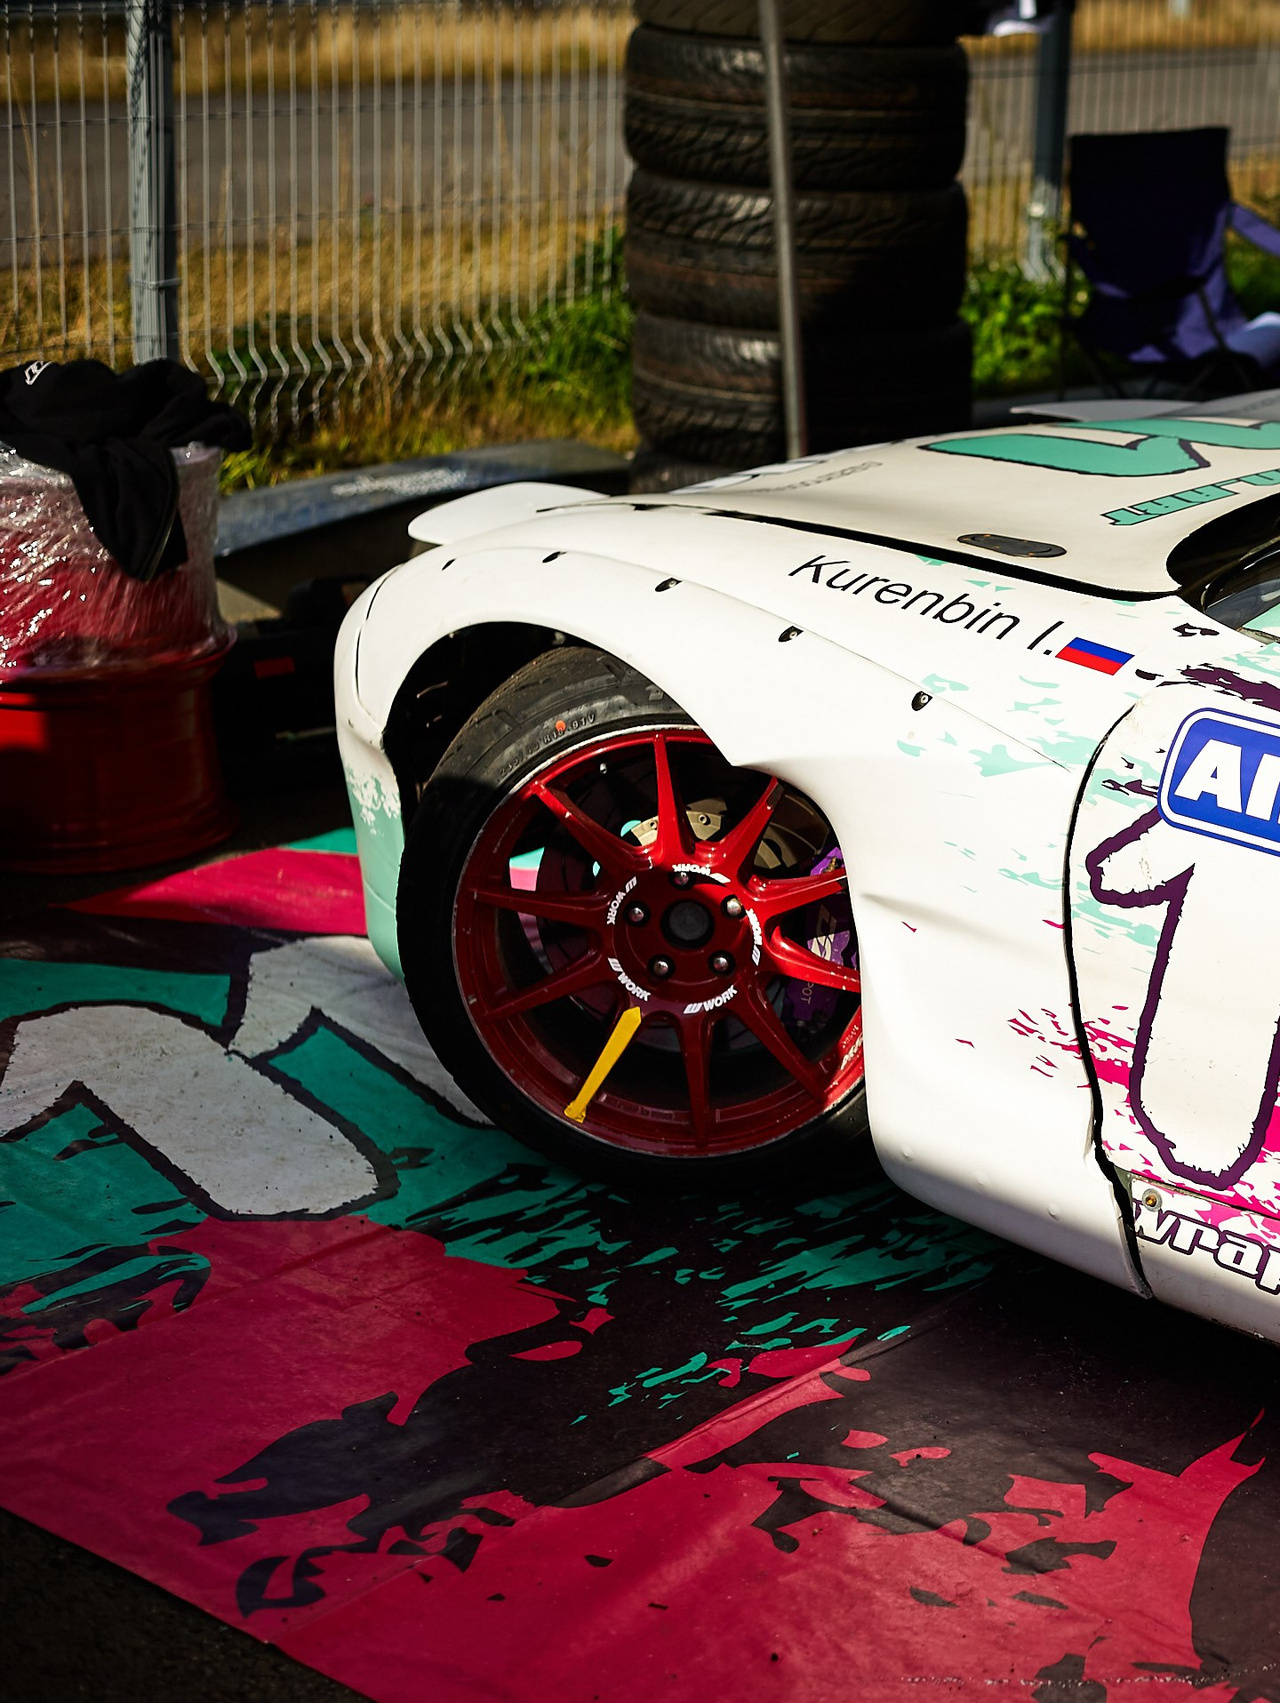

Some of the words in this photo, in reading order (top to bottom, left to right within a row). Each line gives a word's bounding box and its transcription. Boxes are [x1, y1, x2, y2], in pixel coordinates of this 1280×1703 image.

[787, 554, 1021, 641] Kurenbin
[606, 890, 627, 926] WORK
[617, 971, 652, 1003] WORK
[702, 984, 739, 1012] WORK
